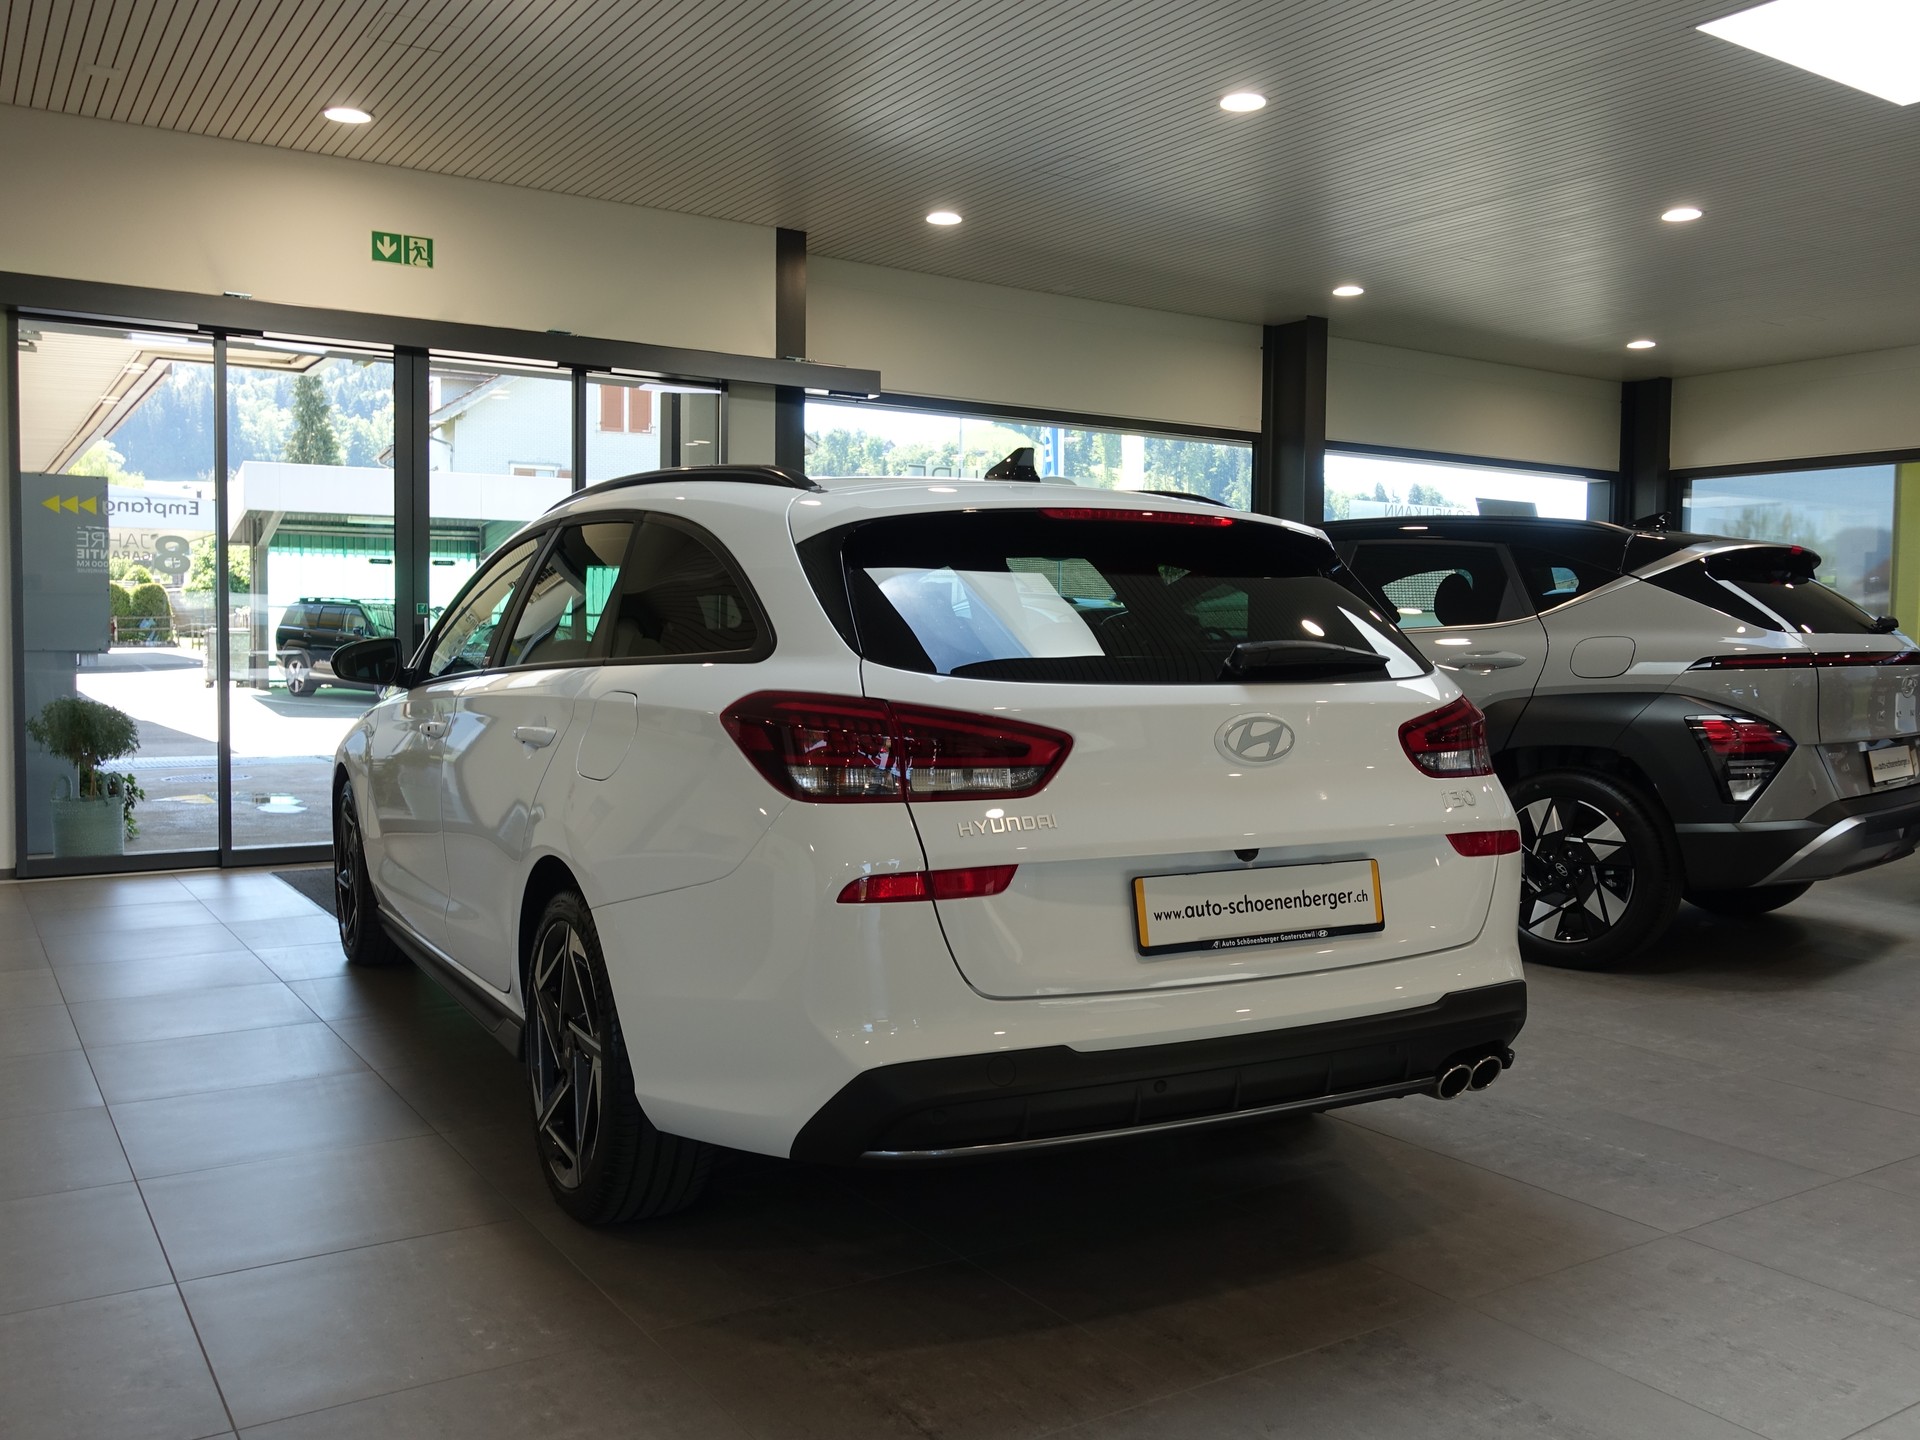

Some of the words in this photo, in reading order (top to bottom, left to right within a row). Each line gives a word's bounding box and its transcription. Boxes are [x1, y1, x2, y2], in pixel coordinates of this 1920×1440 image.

[957, 813, 1058, 837] HYUNDAI
[1153, 889, 1369, 921] www.auto-schoenenberger.ch
[1237, 935, 1280, 947] Schönenberger
